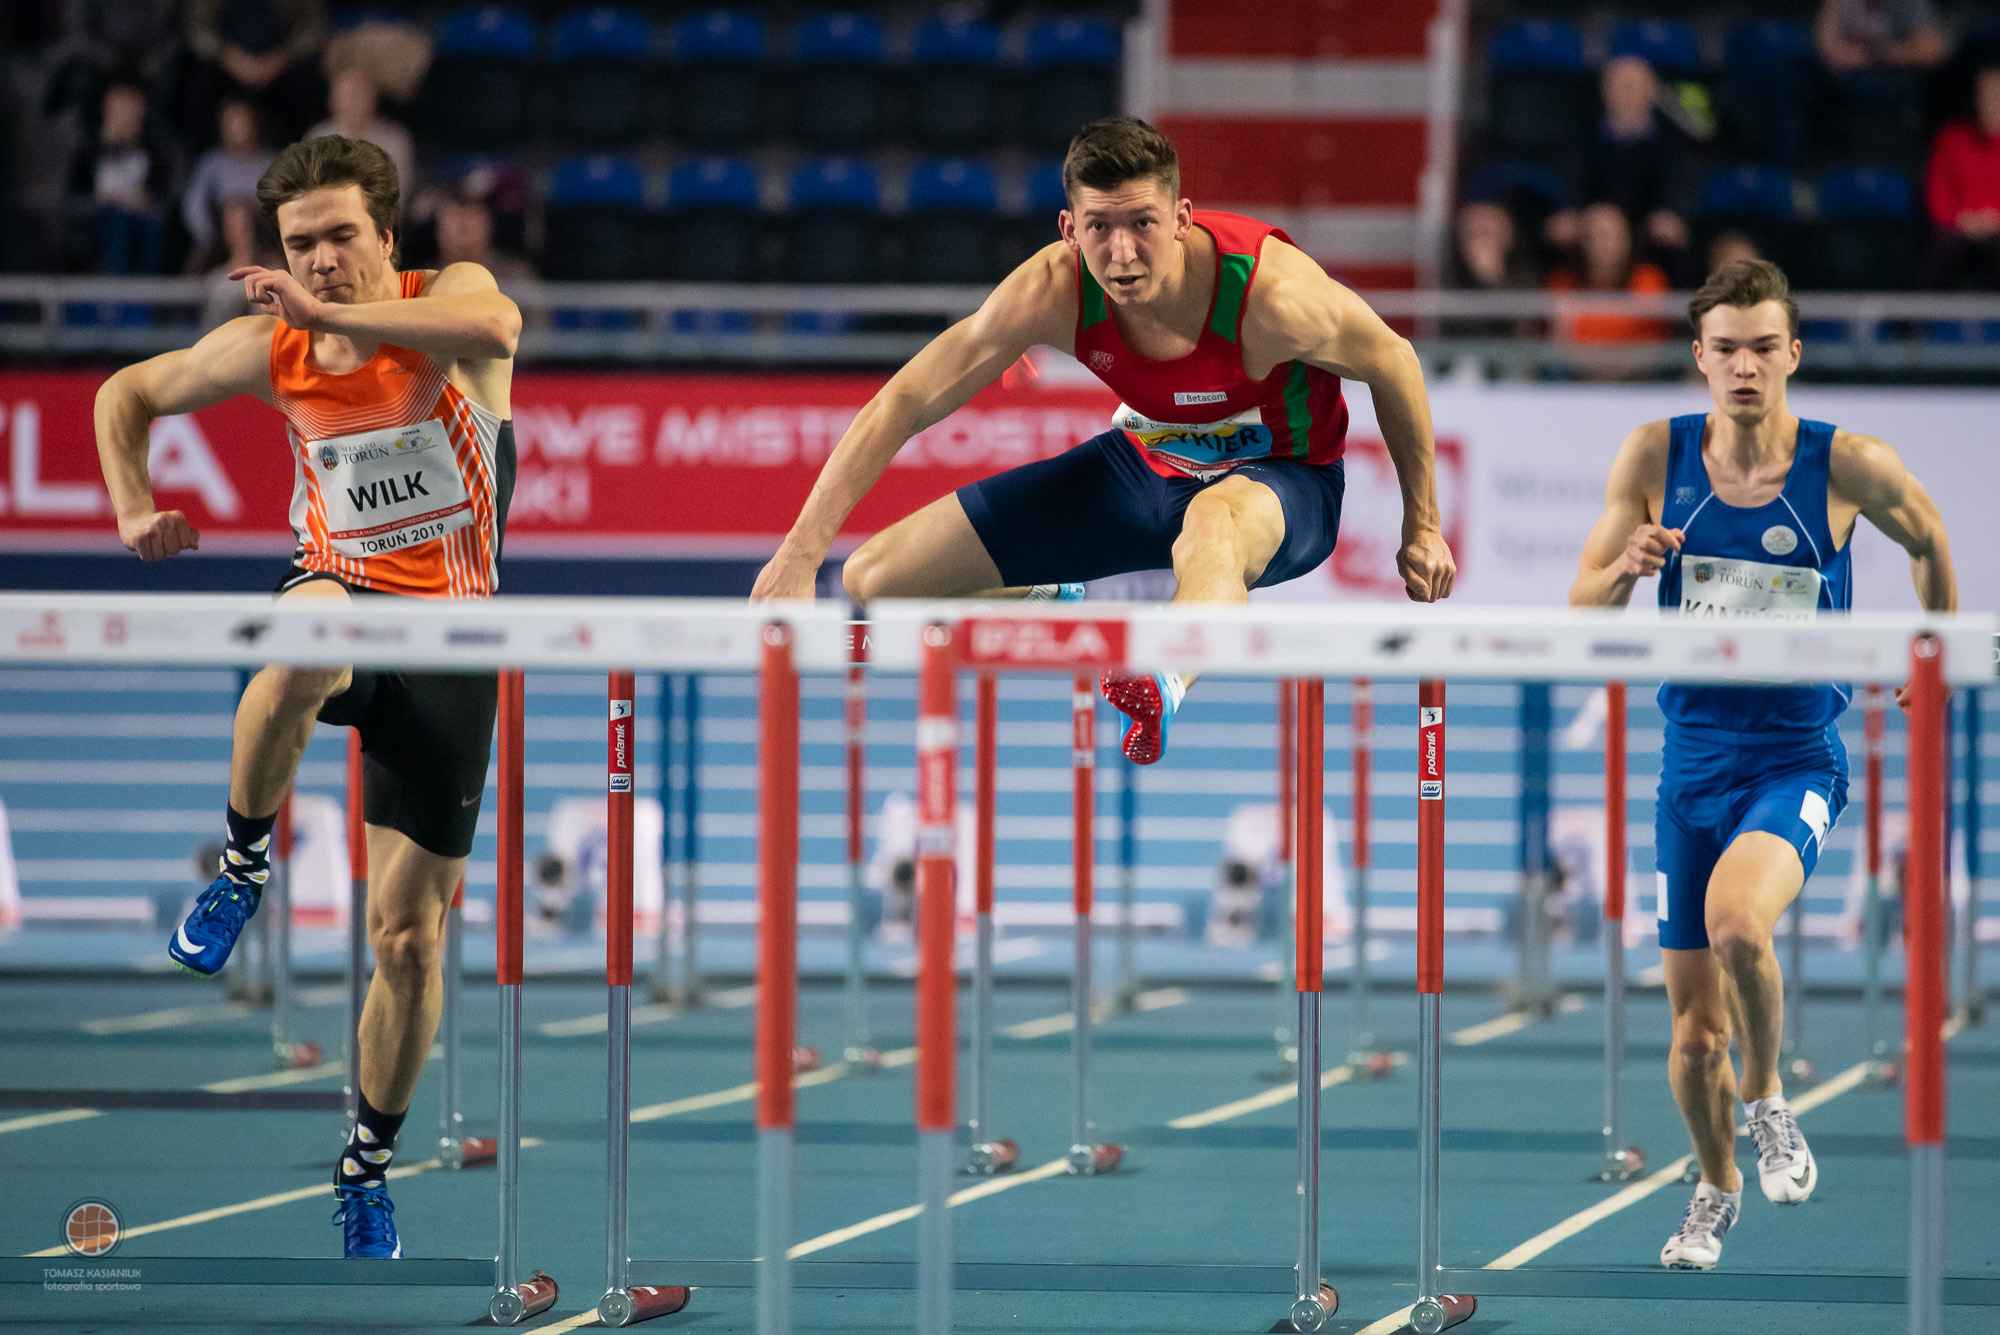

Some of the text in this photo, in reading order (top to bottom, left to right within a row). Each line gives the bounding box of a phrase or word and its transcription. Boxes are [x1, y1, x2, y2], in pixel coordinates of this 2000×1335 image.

[1186, 394, 1227, 403] Betacom
[0, 402, 243, 516] LA
[341, 442, 376, 452] MIASTO
[342, 444, 390, 464] TORUŃ
[346, 471, 430, 512] WILK
[365, 525, 391, 536] HALOWE
[392, 512, 439, 529] MISTRZOSTWA
[440, 505, 463, 516] POLSKI
[360, 523, 444, 553] TORUŃ 2019
[1720, 573, 1764, 590] TORUŃ
[615, 723, 627, 768] polanik
[1426, 730, 1438, 776] polanik
